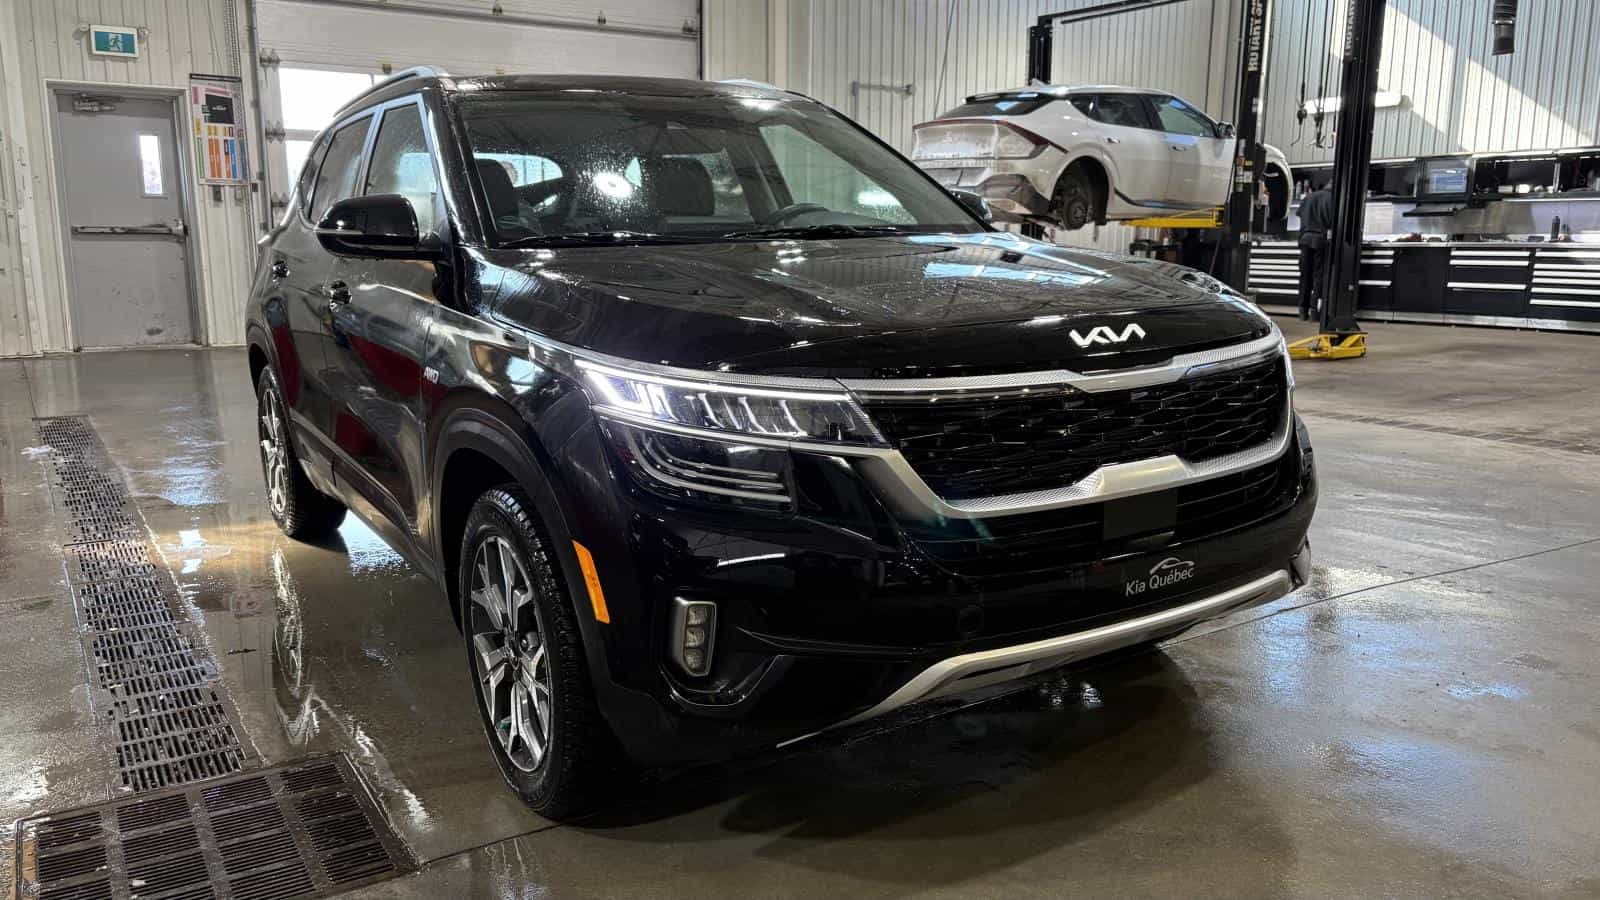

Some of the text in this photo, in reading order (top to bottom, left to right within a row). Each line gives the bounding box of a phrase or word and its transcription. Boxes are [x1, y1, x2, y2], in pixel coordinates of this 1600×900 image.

[1069, 323, 1146, 347] KIA
[1125, 567, 1194, 597] Kia Québec
